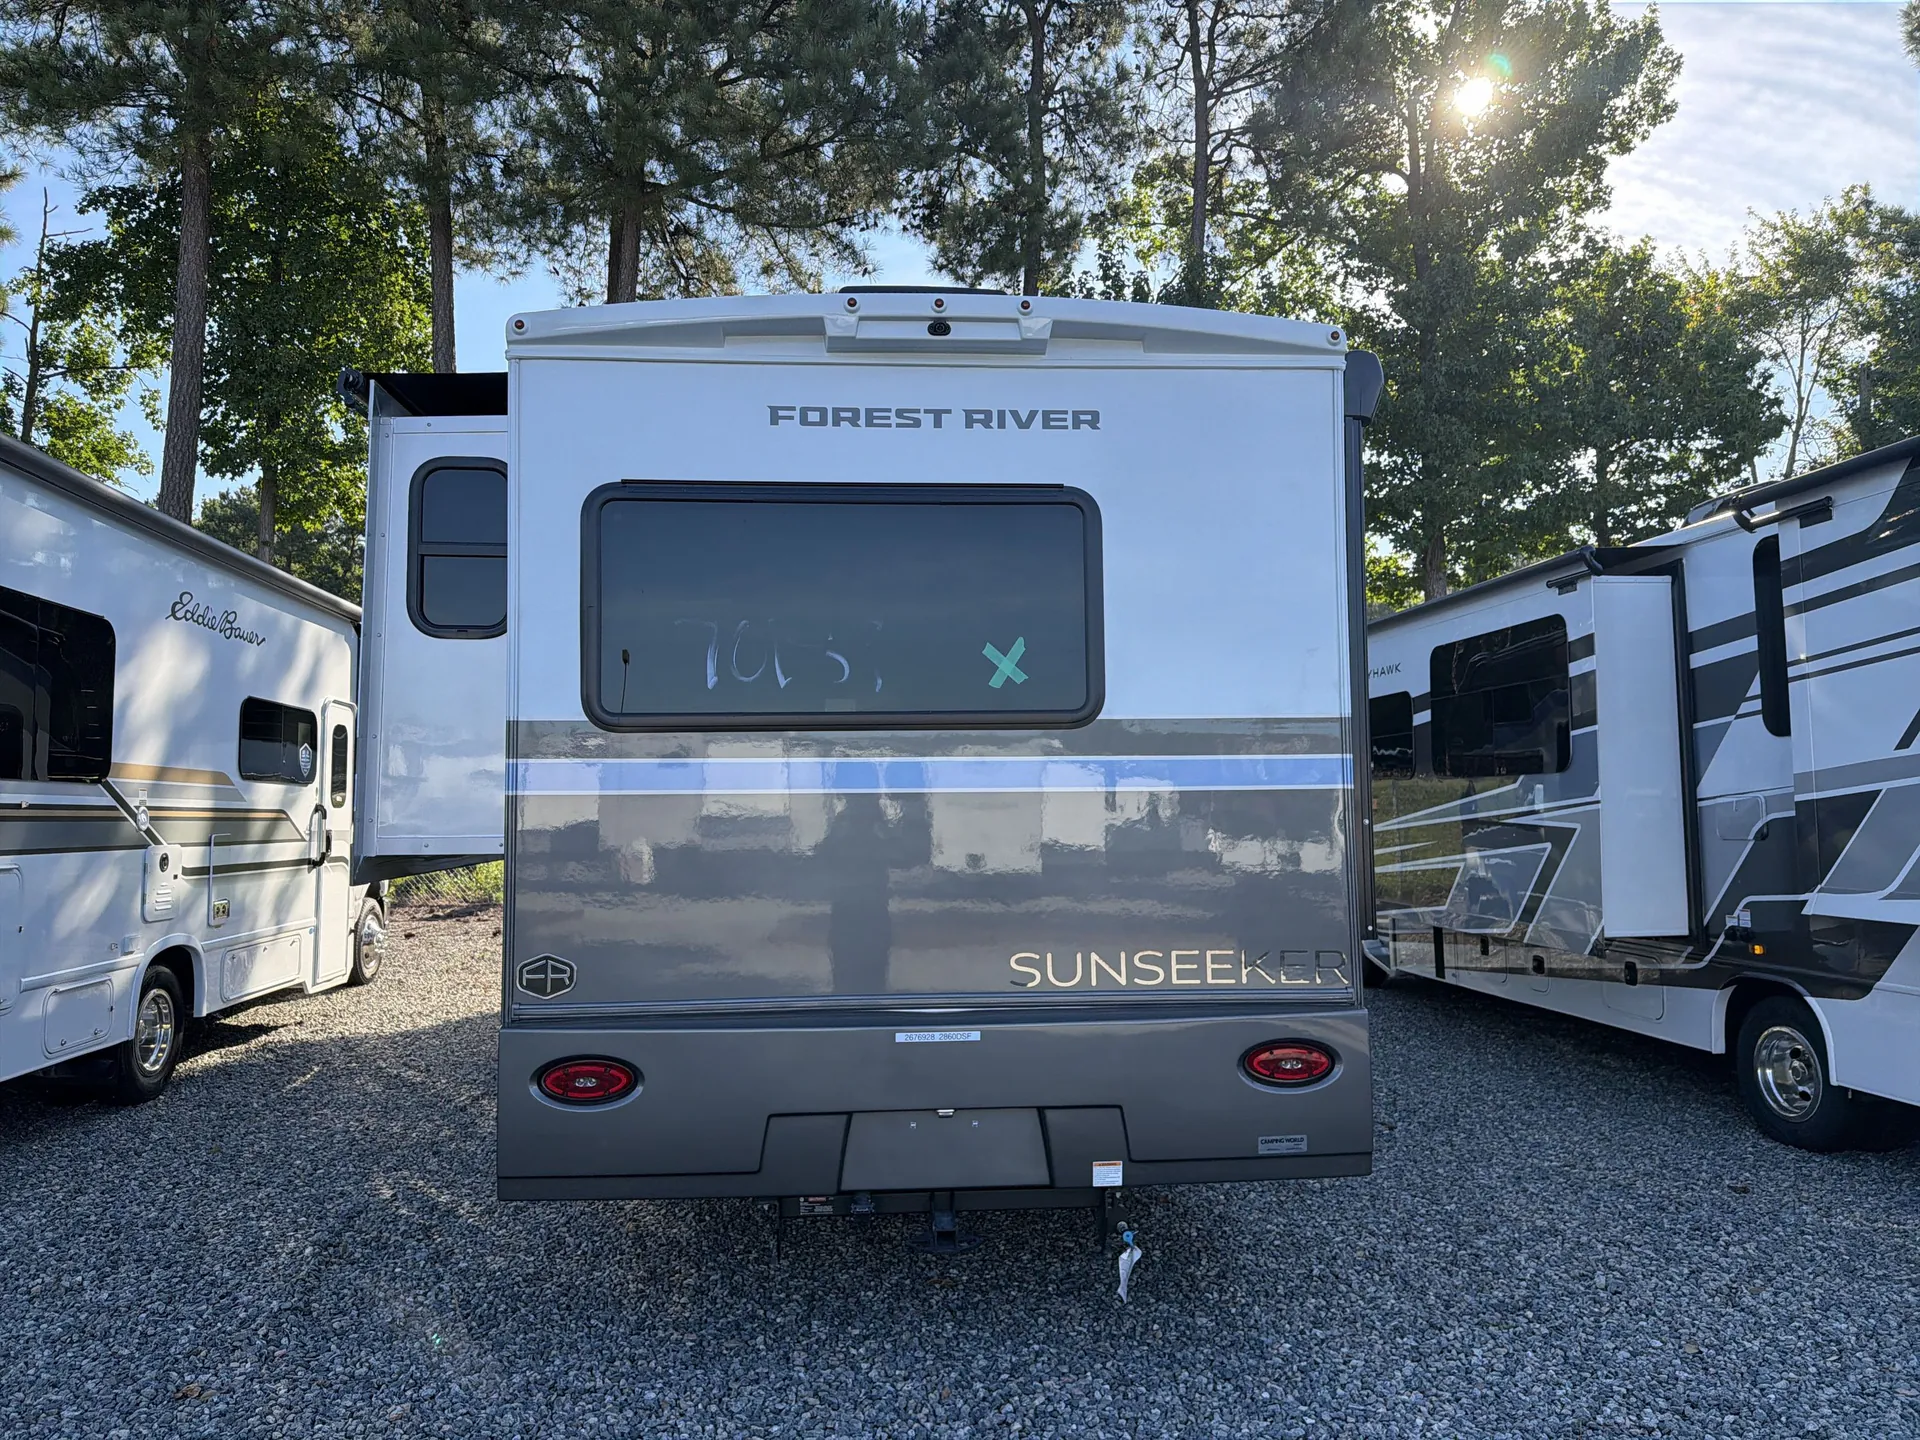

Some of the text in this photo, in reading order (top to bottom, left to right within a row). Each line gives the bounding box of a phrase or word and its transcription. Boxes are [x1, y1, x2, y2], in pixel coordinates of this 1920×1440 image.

[767, 405, 1101, 430] FOREST RIVER
[165, 591, 266, 646] Eddie Bauer
[1009, 949, 1350, 987] SUNSEEKER
[904, 1032, 972, 1041] 2676928 2860DSF
